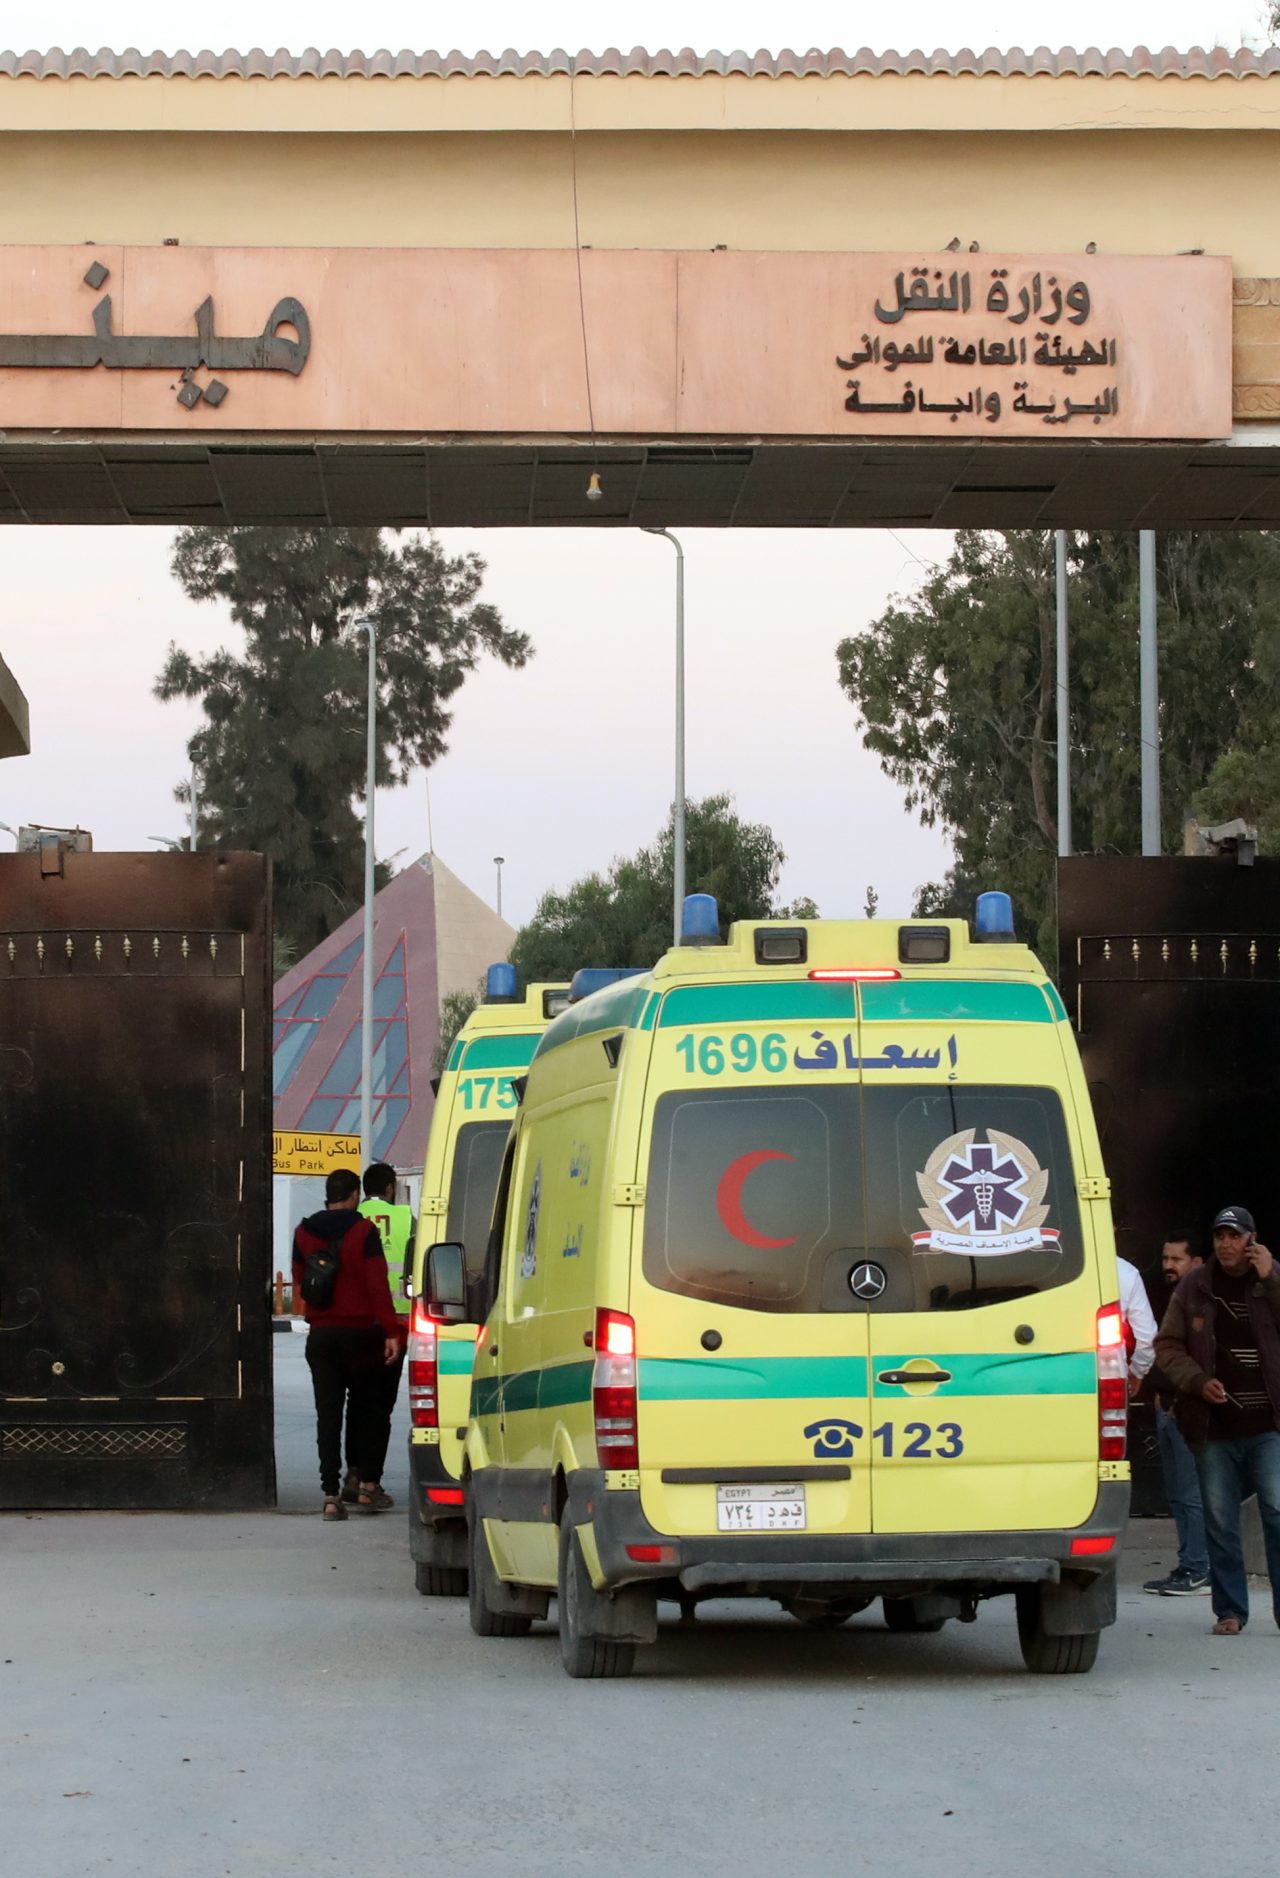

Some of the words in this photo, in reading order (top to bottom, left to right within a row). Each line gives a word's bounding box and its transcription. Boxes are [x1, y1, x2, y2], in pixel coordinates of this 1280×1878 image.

[874, 267, 971, 324] النقل
[986, 268, 1090, 326] وزارة
[938, 335, 1027, 366] العامة
[1034, 332, 1116, 375] الهيئة
[1012, 382, 1119, 424] البرية
[675, 1032, 788, 1076] 1696
[793, 1030, 959, 1081] إسعاف
[288, 1138, 322, 1155] انتظار
[300, 1160, 325, 1170] Park
[873, 1422, 964, 1458] 123
[725, 1489, 752, 1498] EGYPT
